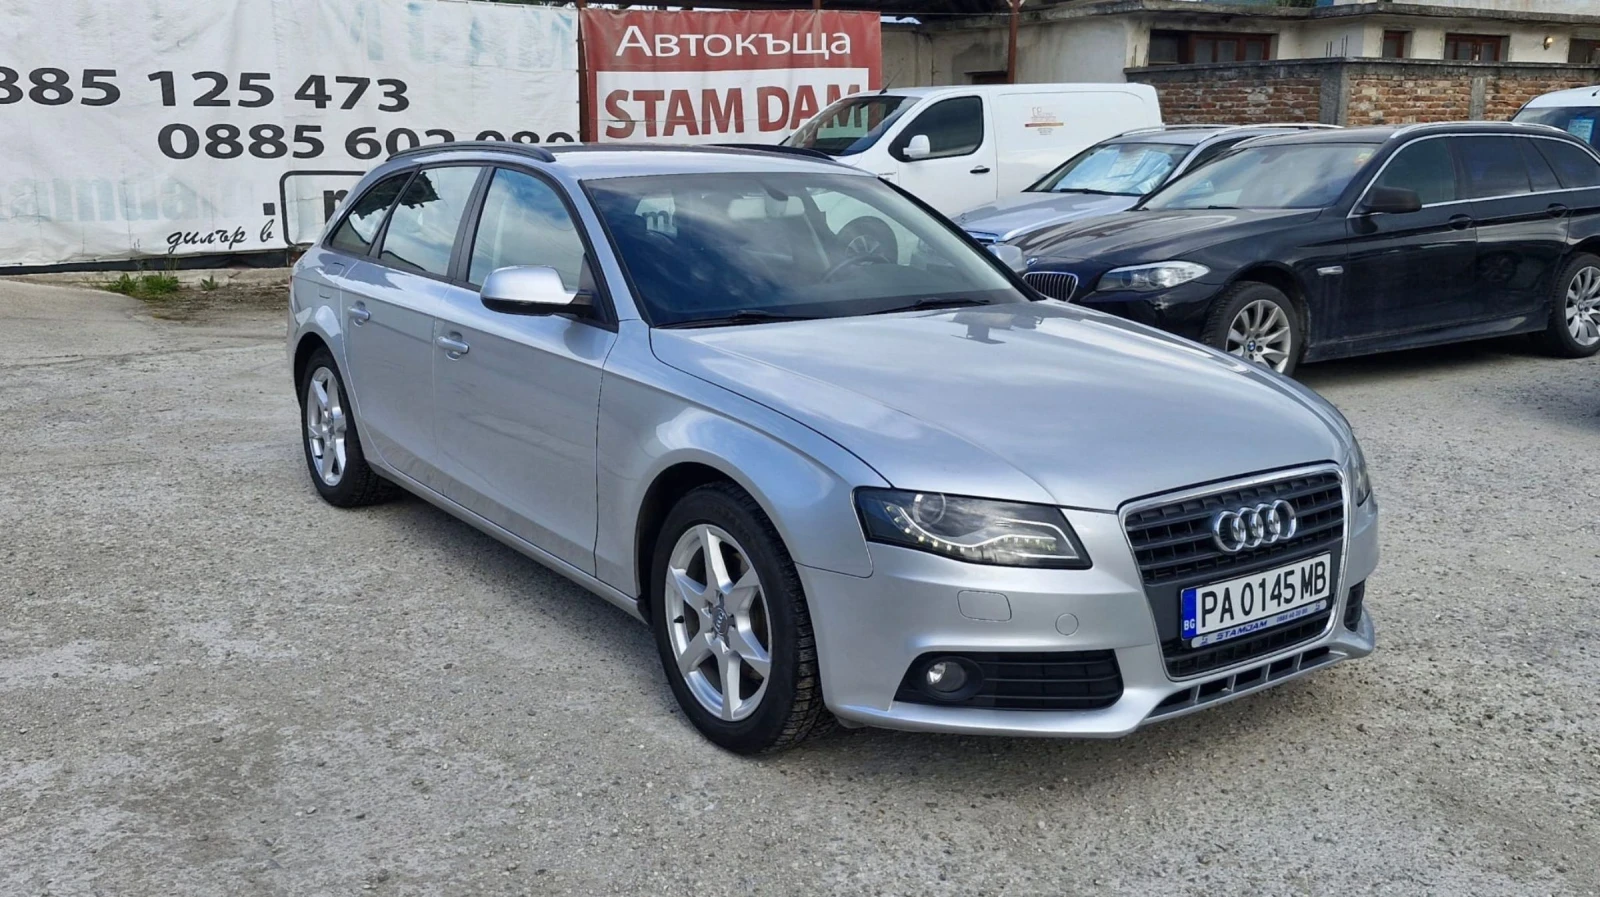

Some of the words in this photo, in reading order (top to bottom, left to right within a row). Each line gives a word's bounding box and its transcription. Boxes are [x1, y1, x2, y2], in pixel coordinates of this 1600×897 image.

[615, 25, 852, 60] Автокъща
[147, 70, 275, 108] 125
[294, 74, 410, 113] 473
[605, 86, 744, 139] STAM
[757, 84, 862, 132] DAM
[157, 123, 325, 160] 0885
[166, 226, 247, 254] дилър
[259, 218, 275, 243] в
[1201, 587, 1235, 628] PA
[1240, 569, 1296, 617] 0145
[1300, 560, 1327, 600] MB
[1183, 618, 1195, 630] BG
